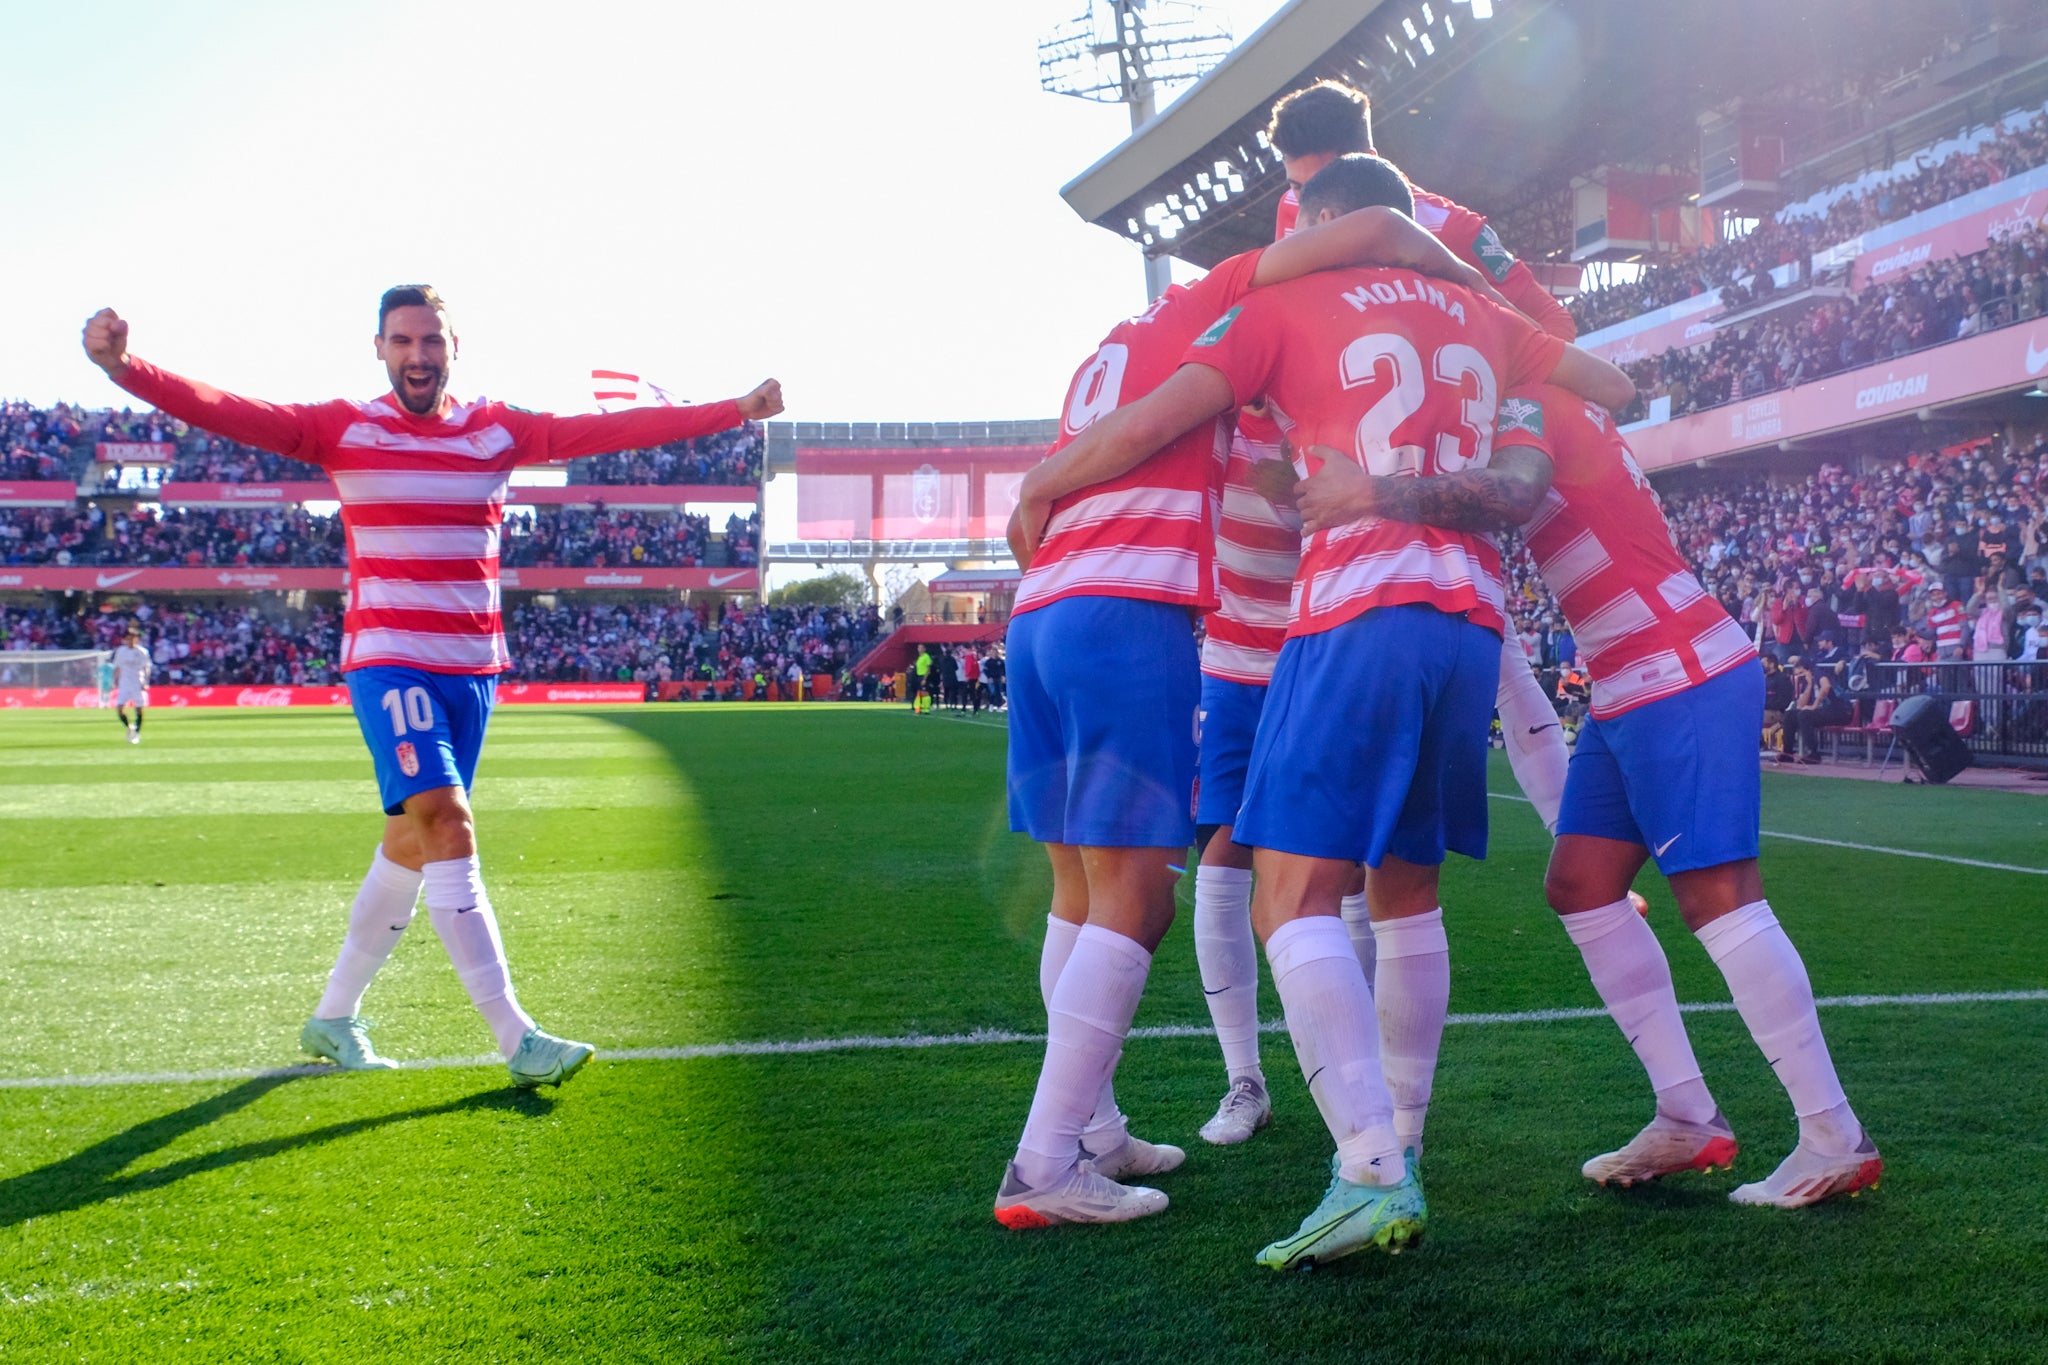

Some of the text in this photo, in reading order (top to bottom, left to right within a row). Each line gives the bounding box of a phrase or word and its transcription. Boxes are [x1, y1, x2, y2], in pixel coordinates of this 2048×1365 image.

[1341, 279, 1466, 326] MOLINA
[1064, 342, 1129, 436] 9
[1339, 333, 1498, 478] 23
[381, 686, 434, 737] 10
